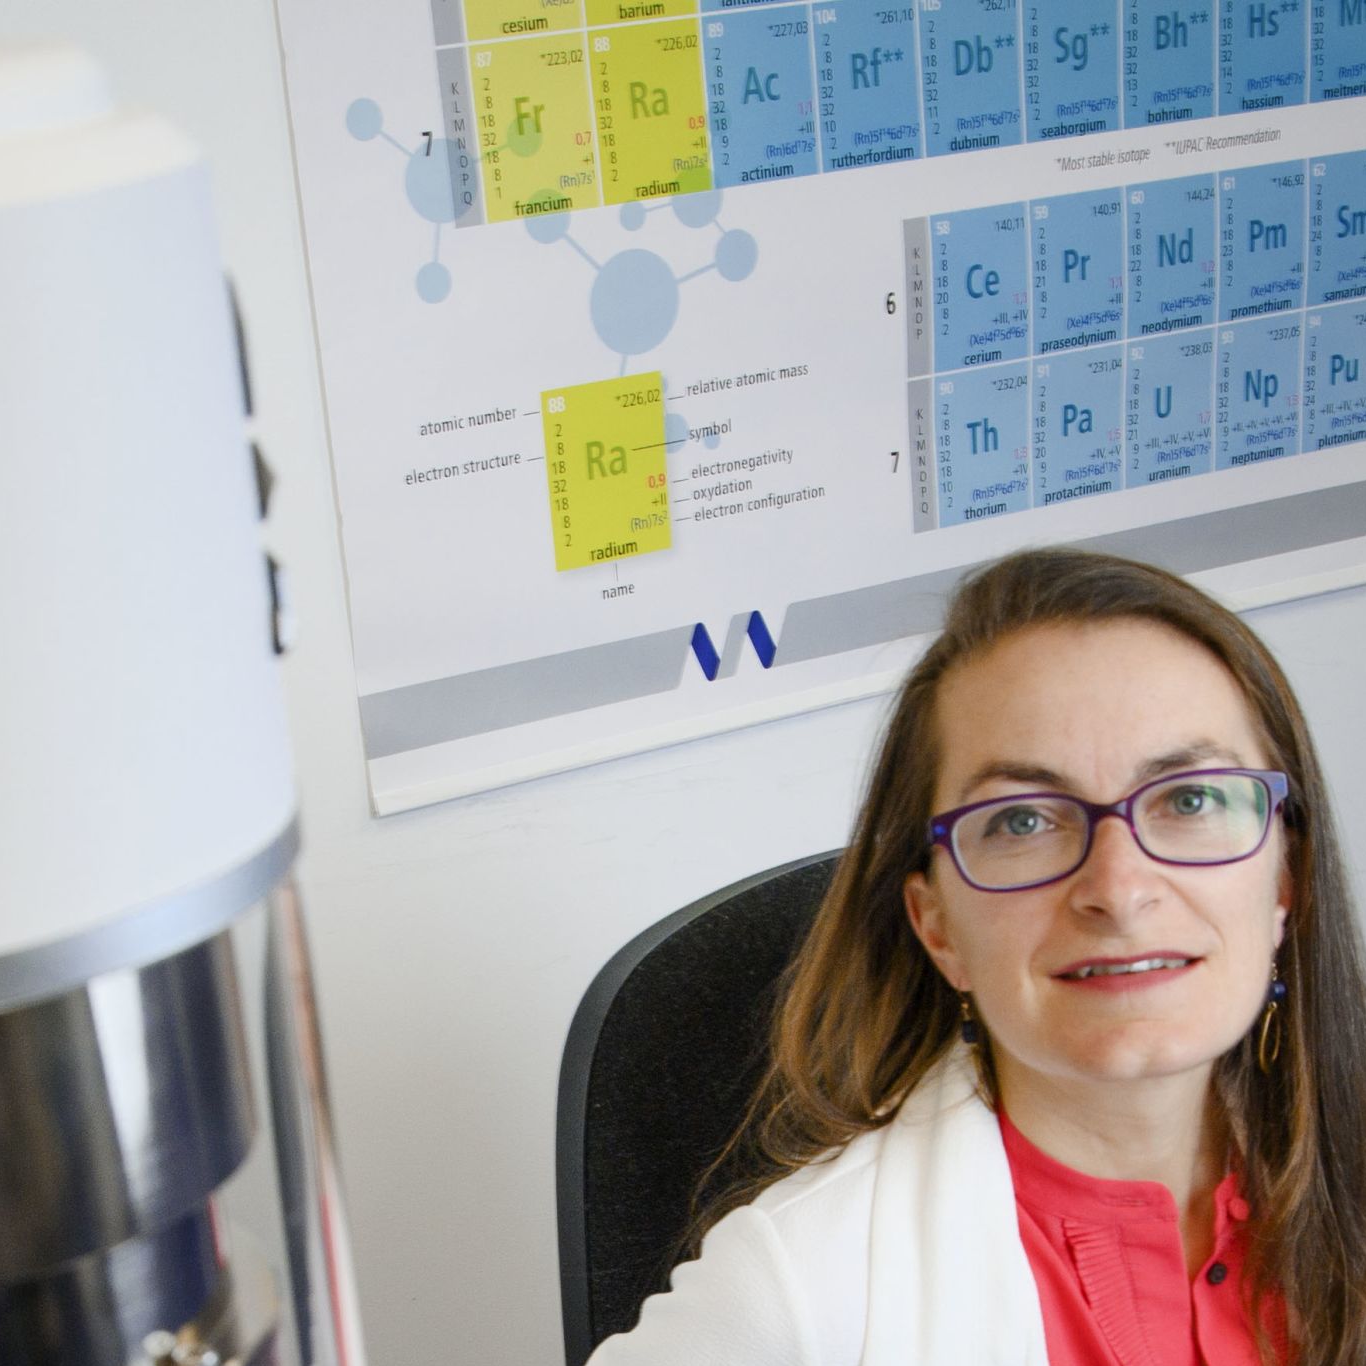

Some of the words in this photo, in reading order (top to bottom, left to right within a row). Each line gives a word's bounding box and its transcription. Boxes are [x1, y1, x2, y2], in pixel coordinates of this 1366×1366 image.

[619, 3, 665, 19] barium
[502, 17, 548, 33] cesium
[600, 63, 607, 75] 2
[603, 81, 609, 93] 8
[743, 66, 781, 104] Ac
[599, 99, 611, 111] 18
[629, 81, 669, 119] Ra
[1242, 94, 1284, 111] hassium
[482, 115, 495, 127] 18
[514, 97, 545, 135] Fr
[600, 117, 613, 129] 32
[689, 116, 705, 130] 0,9
[1147, 106, 1193, 123] bohrium
[1041, 118, 1106, 138] seaborgium
[422, 131, 433, 156] 7
[483, 133, 497, 146] 32
[603, 135, 615, 147] 18
[950, 133, 1000, 151] dubnium
[1206, 128, 1281, 150] Recommendation
[831, 145, 915, 169] rutherfordium
[1086, 150, 1116, 168] stable
[1118, 147, 1151, 164] isotope
[741, 163, 794, 182] actinium
[635, 179, 680, 197] radium
[515, 196, 573, 216] francium
[1249, 219, 1286, 252] Pm
[1157, 228, 1194, 267] Nd
[1063, 249, 1091, 283] Pr
[967, 264, 1000, 299] Ce
[887, 292, 896, 315] 6
[1231, 300, 1292, 321] promethium
[1141, 314, 1202, 335] neodymium
[964, 349, 1002, 366] cerium
[1330, 354, 1359, 385] Pu
[686, 376, 732, 397] relative
[735, 368, 776, 388] atomic
[779, 364, 809, 380] mass
[1244, 369, 1279, 407] Np
[547, 396, 566, 413] 88
[1155, 385, 1172, 418] U
[420, 412, 466, 436] atomic
[468, 406, 518, 427] number
[689, 418, 733, 441] symbol
[1063, 403, 1093, 436] Pa
[554, 424, 563, 437] 2
[967, 418, 999, 455] Th
[1318, 429, 1366, 449] plutonium
[557, 442, 565, 456] 8
[1231, 446, 1284, 466] neptunium
[405, 464, 460, 485] electron
[463, 450, 521, 475] structure
[552, 461, 566, 474] 18
[586, 440, 628, 480] Ra
[691, 448, 794, 480] electronegativity
[890, 451, 900, 474] 7
[647, 473, 666, 488] 0,9
[1149, 464, 1191, 482] uranium
[553, 479, 567, 493] 32
[693, 477, 753, 502] oxydation
[1044, 479, 1112, 505] protactinium
[554, 497, 569, 511] 18
[694, 501, 744, 522] electron
[747, 484, 826, 514] configuration
[964, 501, 1007, 520] thorium
[563, 515, 570, 529] 8
[564, 534, 572, 547] 2
[590, 539, 638, 562] radium
[602, 582, 635, 600] name
